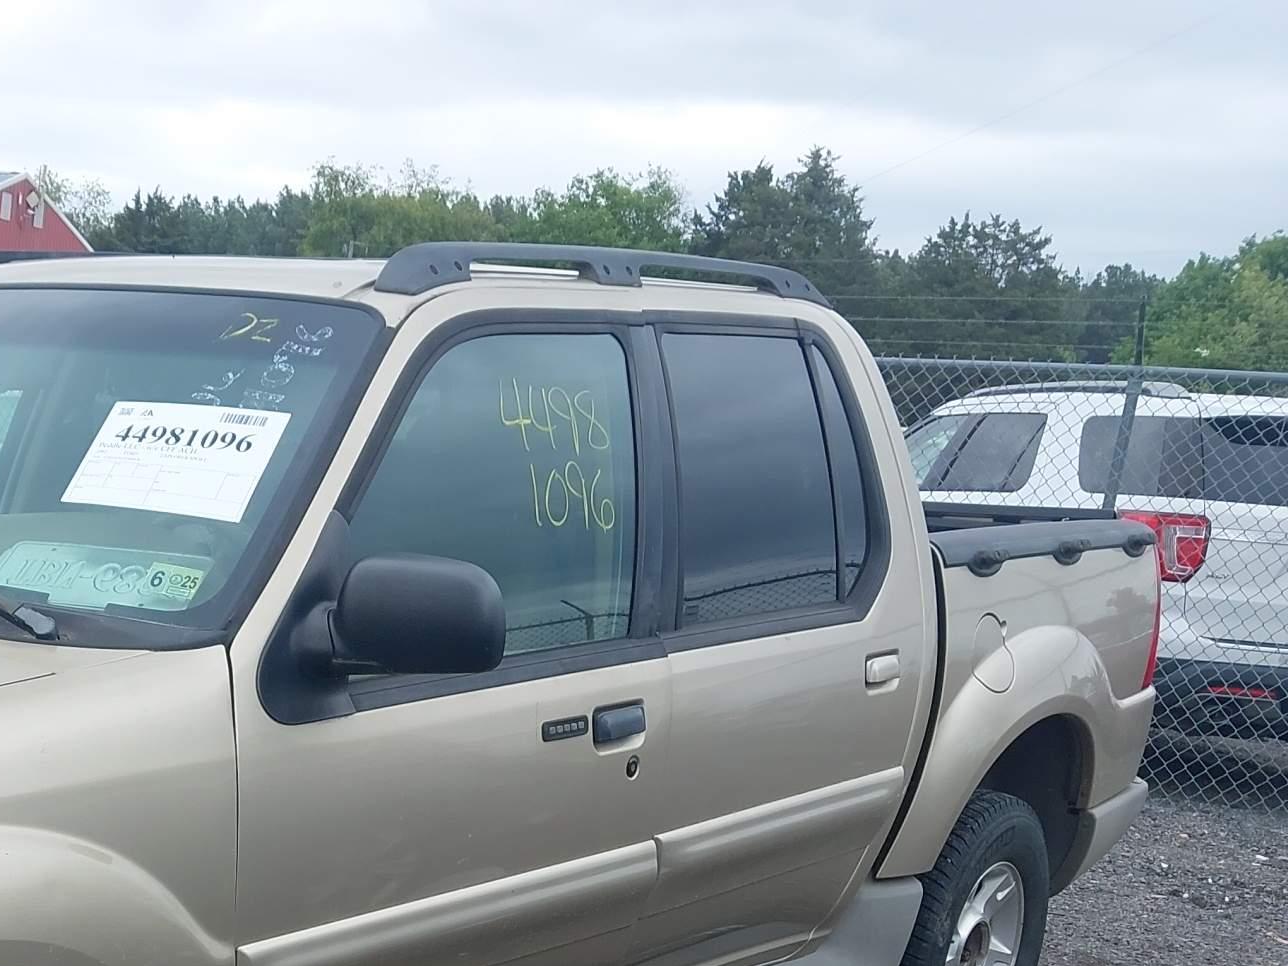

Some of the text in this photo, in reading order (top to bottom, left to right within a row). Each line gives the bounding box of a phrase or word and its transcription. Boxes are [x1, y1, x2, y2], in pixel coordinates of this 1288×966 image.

[114, 423, 257, 453] 44981096
[499, 377, 610, 456] 4498
[529, 460, 615, 533] 1096
[149, 570, 200, 590] 6 25
